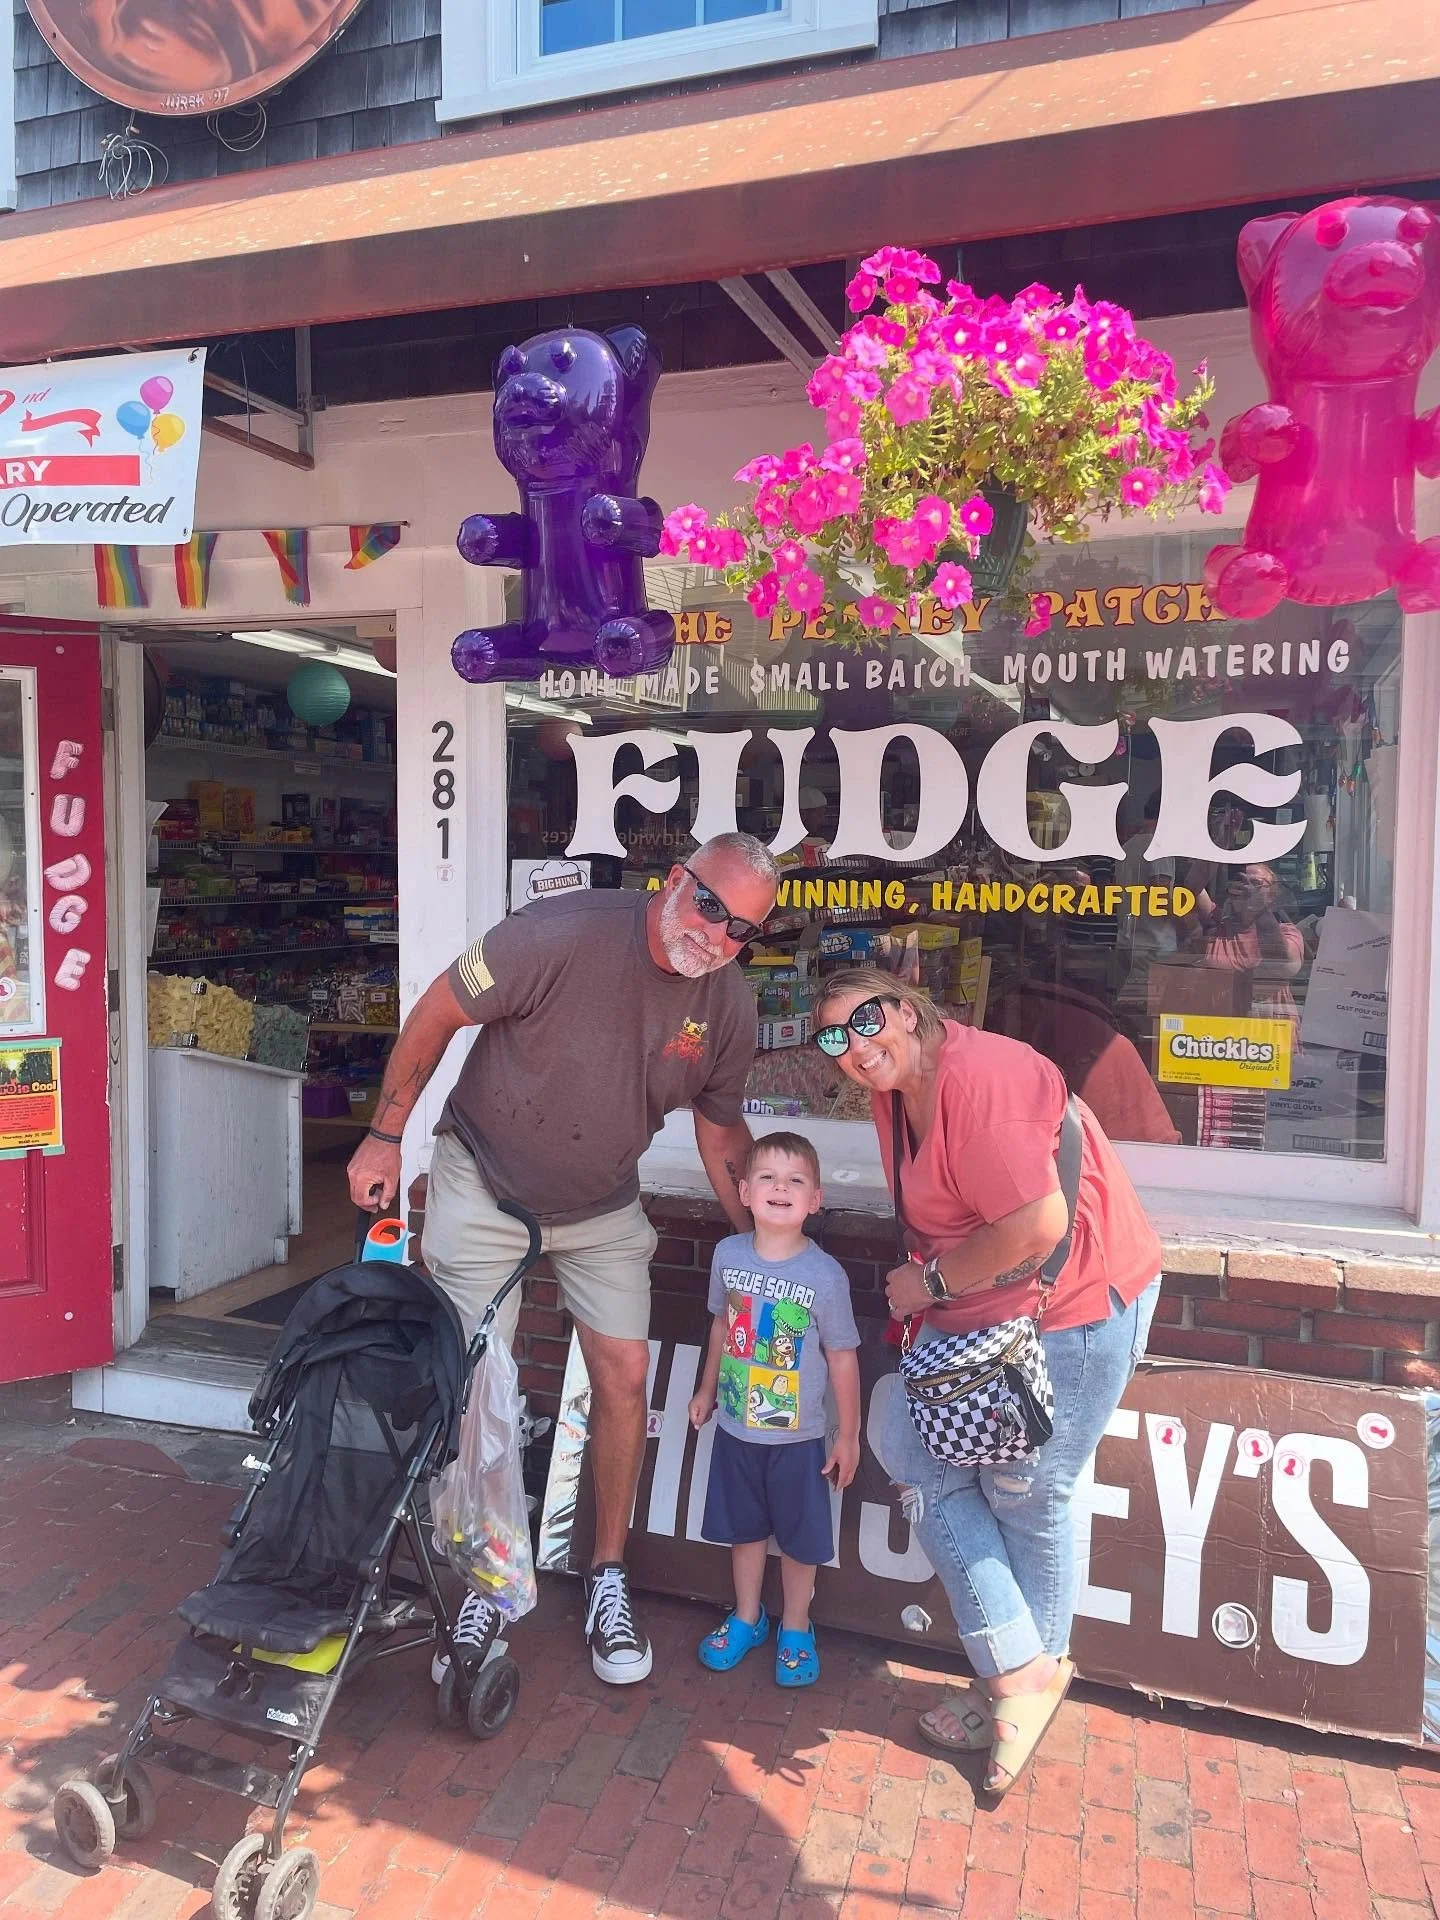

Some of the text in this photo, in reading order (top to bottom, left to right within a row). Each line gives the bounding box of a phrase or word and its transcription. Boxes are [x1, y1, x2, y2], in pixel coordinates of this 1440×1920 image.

[1, 493, 175, 533] Operated
[672, 610, 733, 645] HE
[768, 597, 991, 641] PENEY
[638, 665, 720, 697] MADE
[749, 659, 850, 694] SMALL
[865, 655, 971, 691] BATCH
[1003, 647, 1127, 684] MOUTH
[1145, 639, 1351, 682] WATERING
[431, 720, 456, 860] 281
[564, 712, 1308, 865] FUDGE
[932, 880, 1196, 917] HANDCRAFTED
[821, 935, 849, 947] WAX
[823, 944, 850, 954] LIPS
[764, 987, 790, 998] Fun Dip
[1290, 1080, 1319, 1090] oPak
